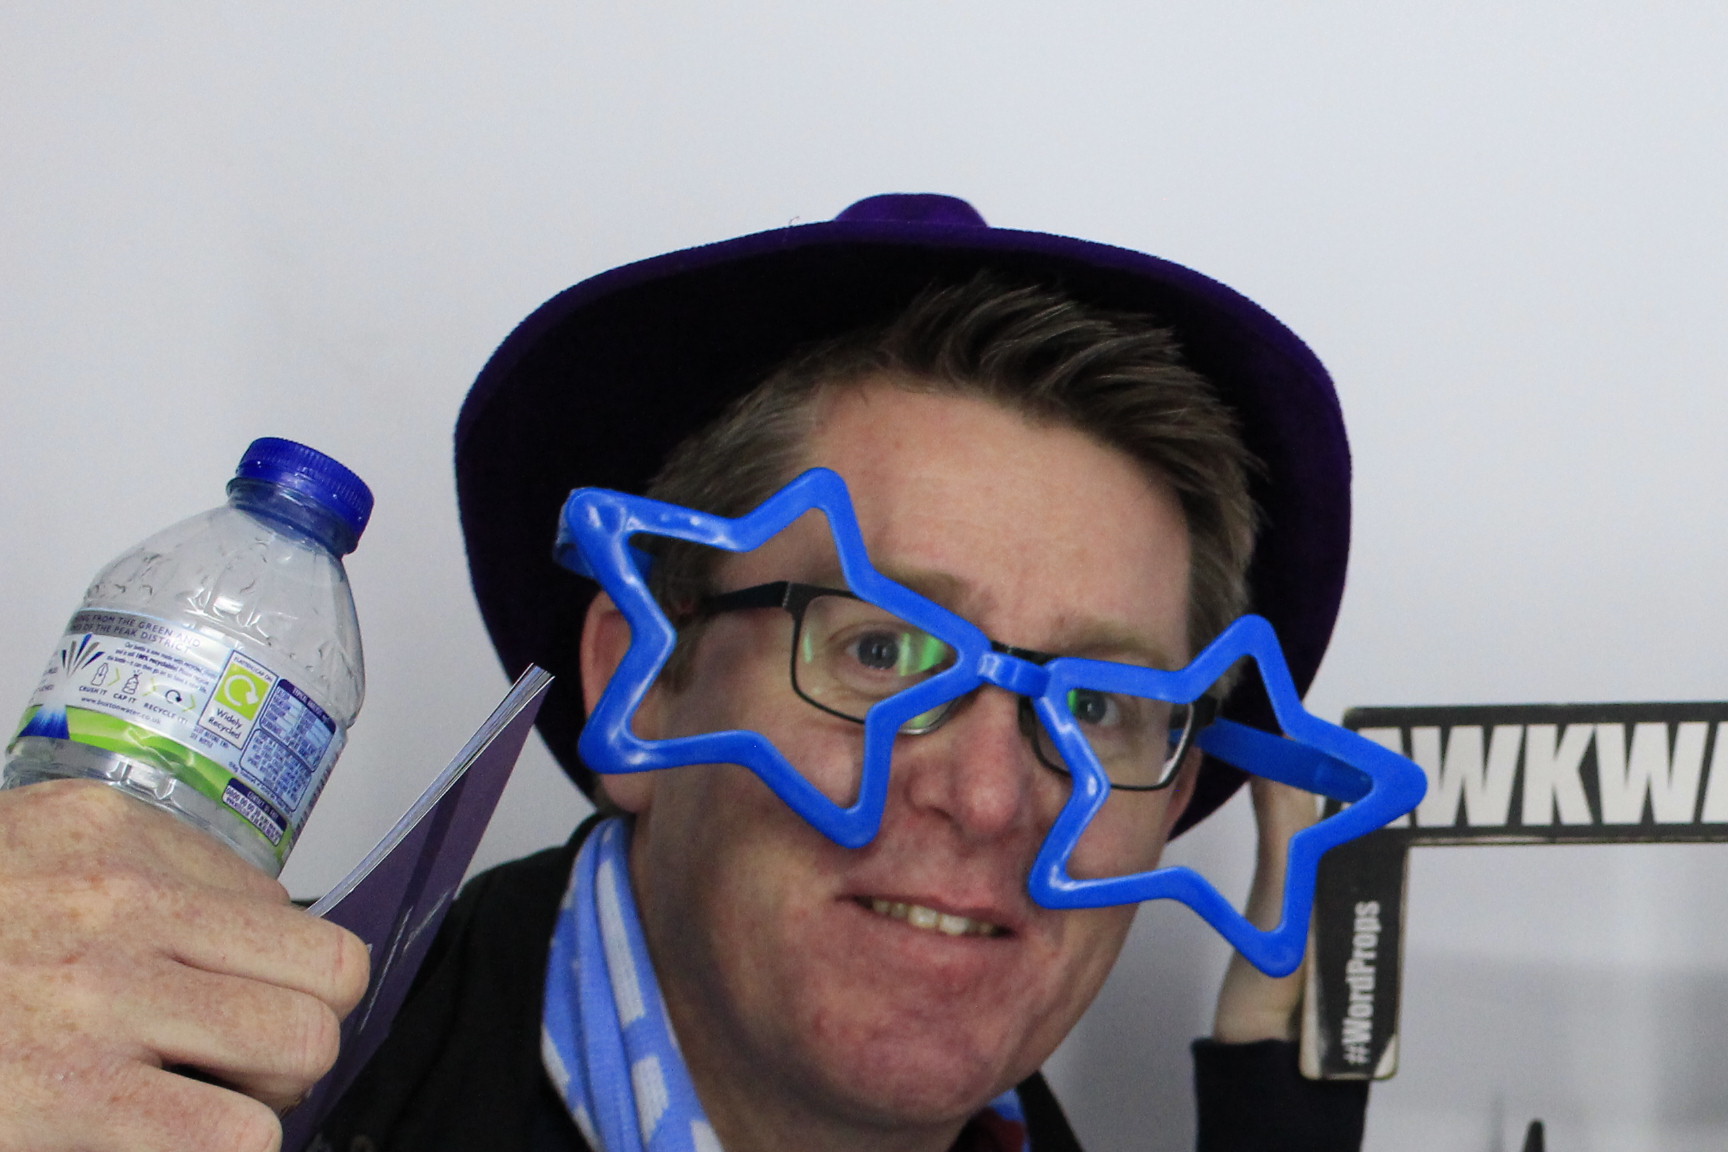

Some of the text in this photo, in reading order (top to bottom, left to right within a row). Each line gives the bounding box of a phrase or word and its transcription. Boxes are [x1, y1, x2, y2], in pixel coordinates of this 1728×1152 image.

[114, 625, 137, 639] PEAK
[140, 631, 192, 654] DISTRICT
[119, 617, 135, 626] THE
[139, 621, 173, 637] GREEN
[175, 633, 201, 648] AND
[79, 685, 108, 696] CRUSH IT
[113, 693, 137, 704] CAP IT
[143, 702, 177, 719] RECYCLE
[216, 708, 242, 731] Widely
[208, 717, 242, 740] Recycled
[1341, 900, 1382, 1065] #WordProps
